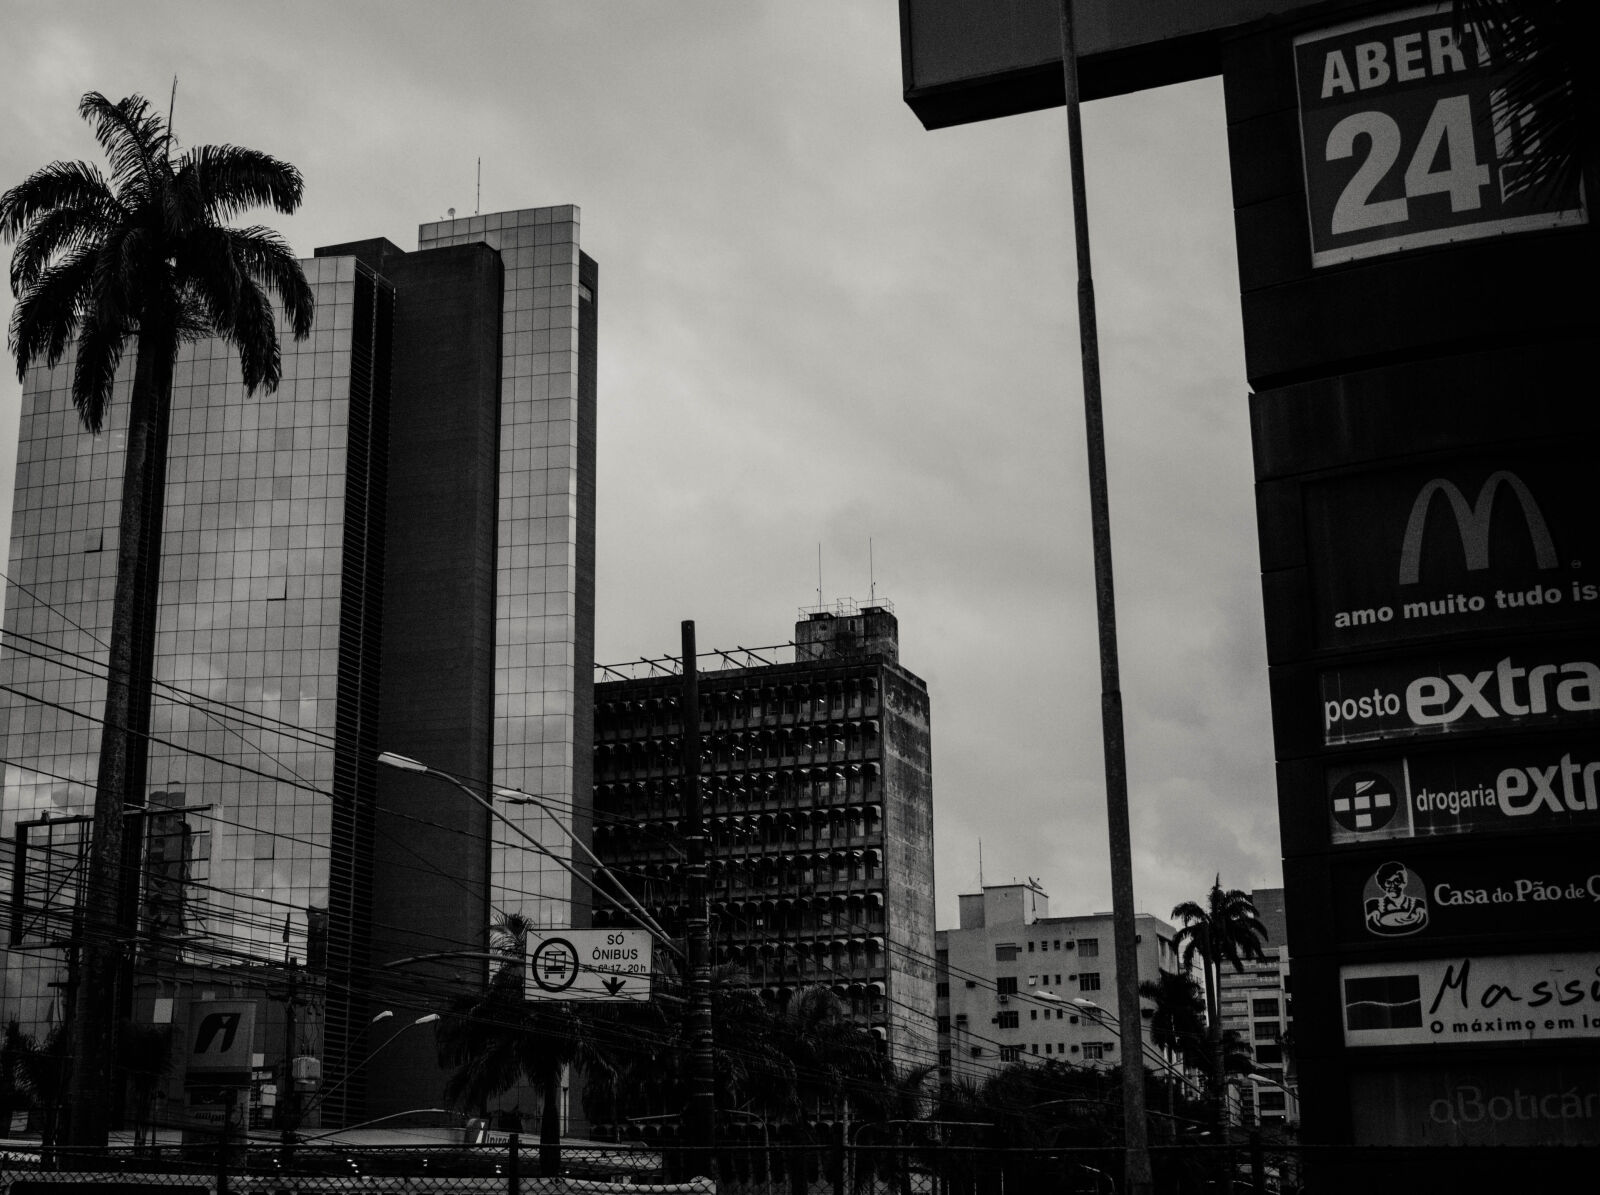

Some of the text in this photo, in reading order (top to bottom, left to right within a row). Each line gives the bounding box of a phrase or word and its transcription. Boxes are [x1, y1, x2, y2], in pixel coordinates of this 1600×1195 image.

[1334, 581, 1600, 629] amo muito tudo is
[1324, 656, 1600, 730] posto extra
[1416, 784, 1497, 815] drogaria
[1434, 883, 1489, 906] Casa
[1492, 887, 1514, 903] do
[1514, 879, 1562, 902] Pão
[1564, 882, 1585, 900] de
[607, 932, 625, 945] SÓ
[592, 947, 638, 960] ÔNIBUS
[1430, 1021, 1444, 1034] O
[1453, 1018, 1536, 1034] máximo
[1544, 1019, 1575, 1031] em
